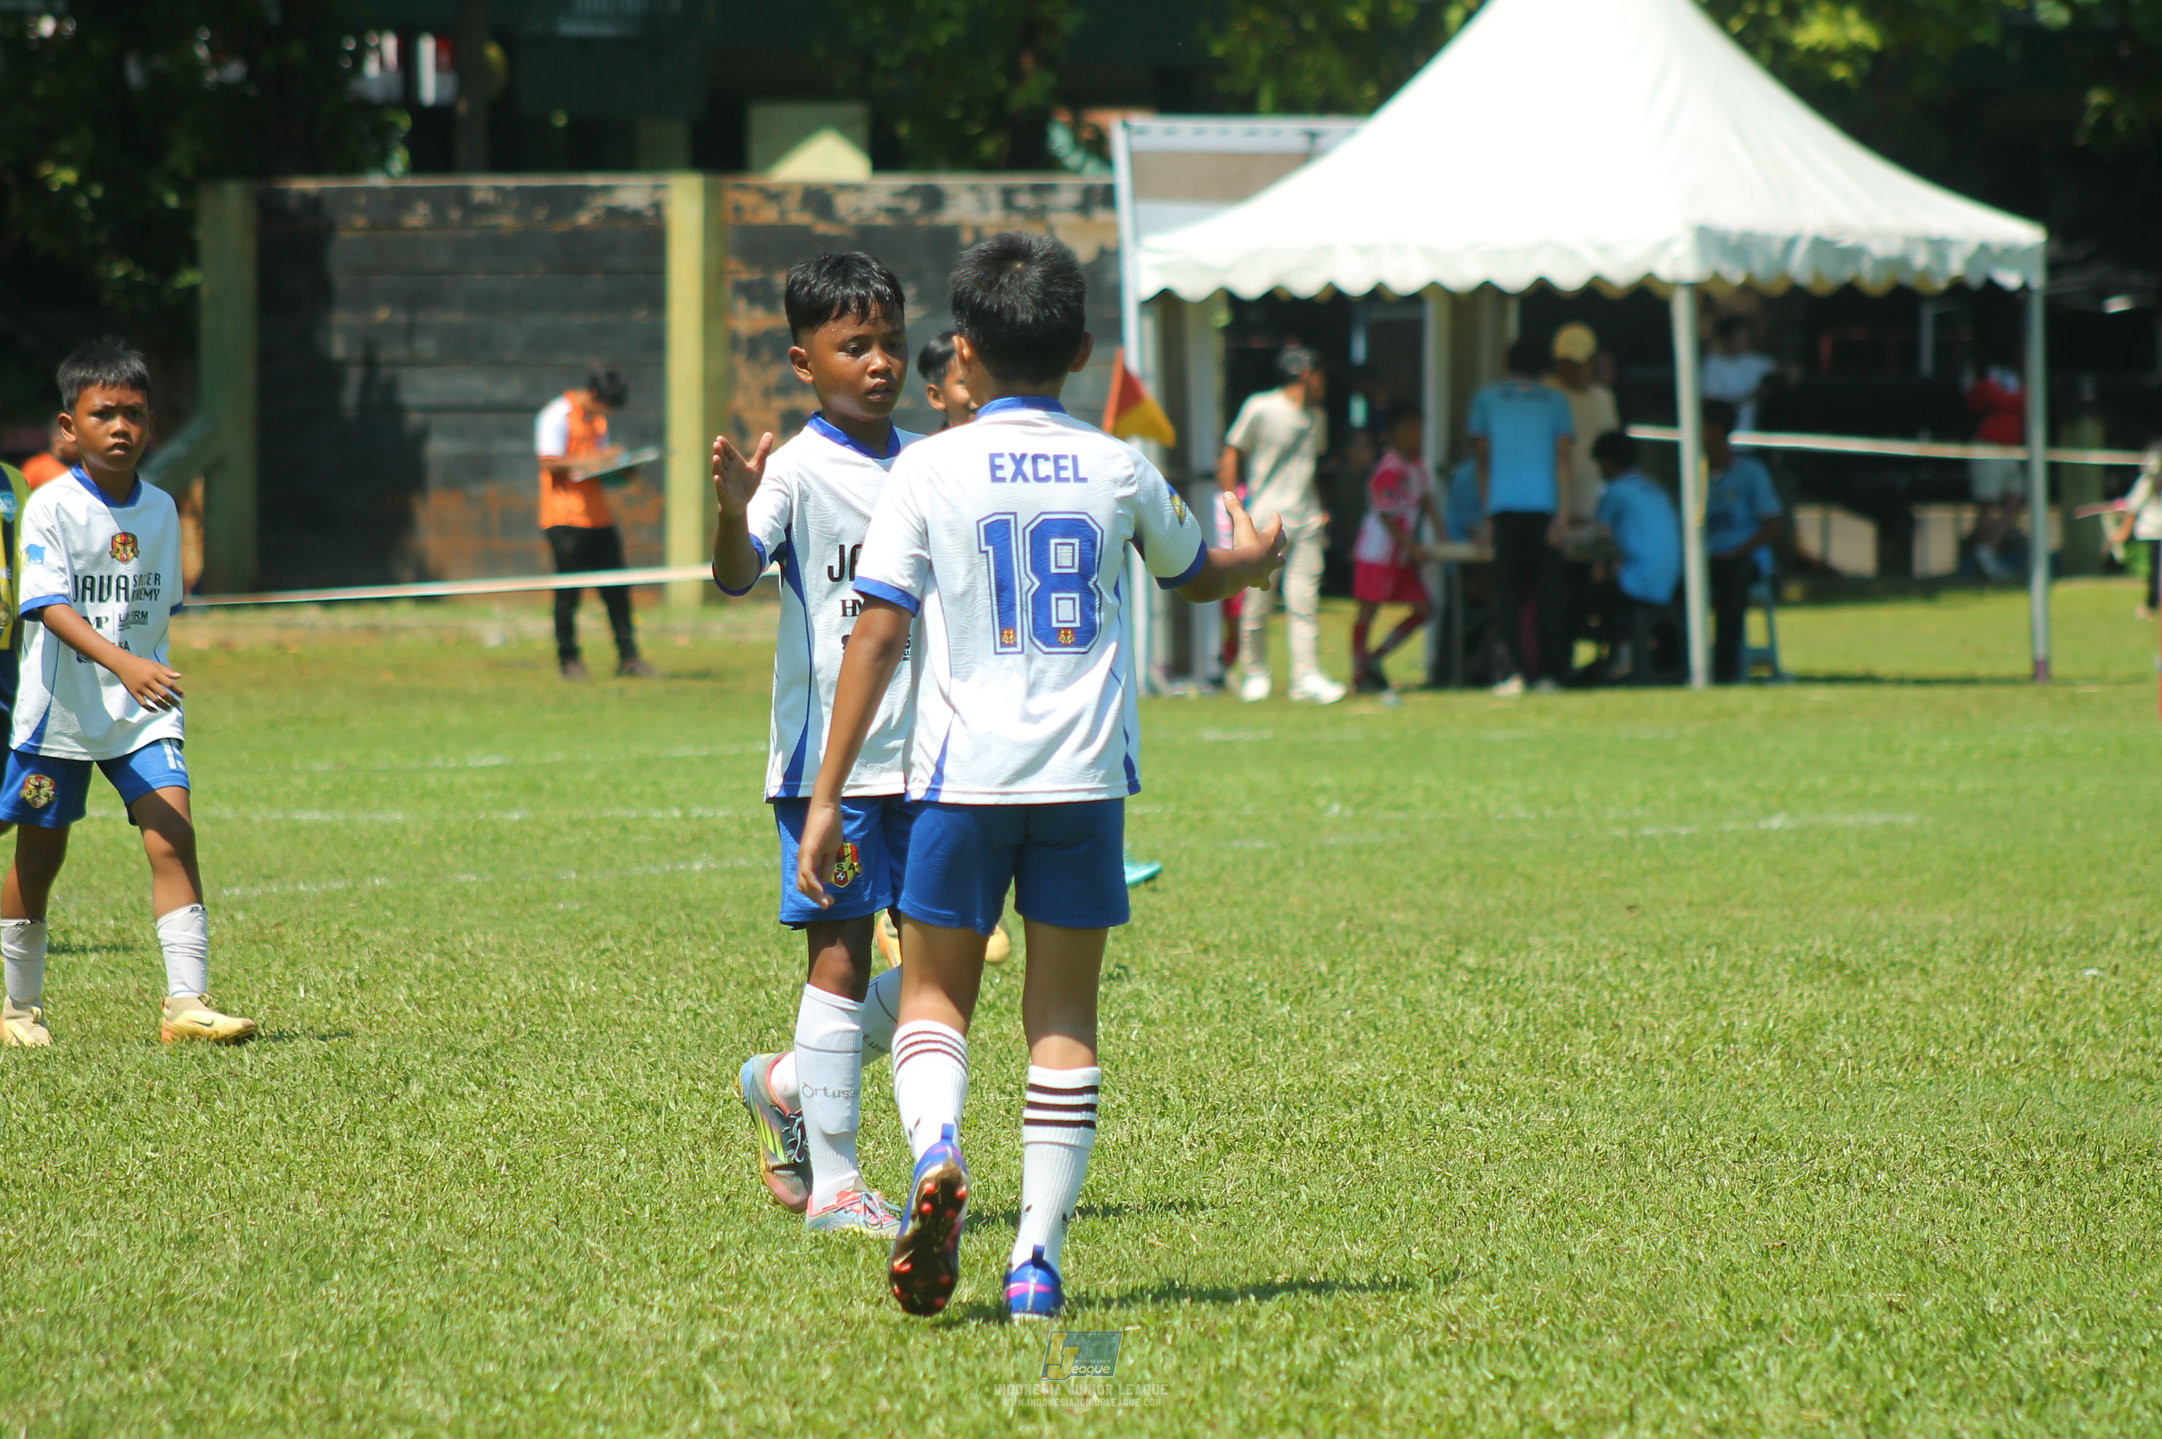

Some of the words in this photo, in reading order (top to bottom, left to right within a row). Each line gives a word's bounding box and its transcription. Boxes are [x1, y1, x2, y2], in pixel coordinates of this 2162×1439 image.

[988, 452, 1089, 484] EXCEL
[73, 574, 130, 603] JAVA
[976, 511, 1104, 655] 18
